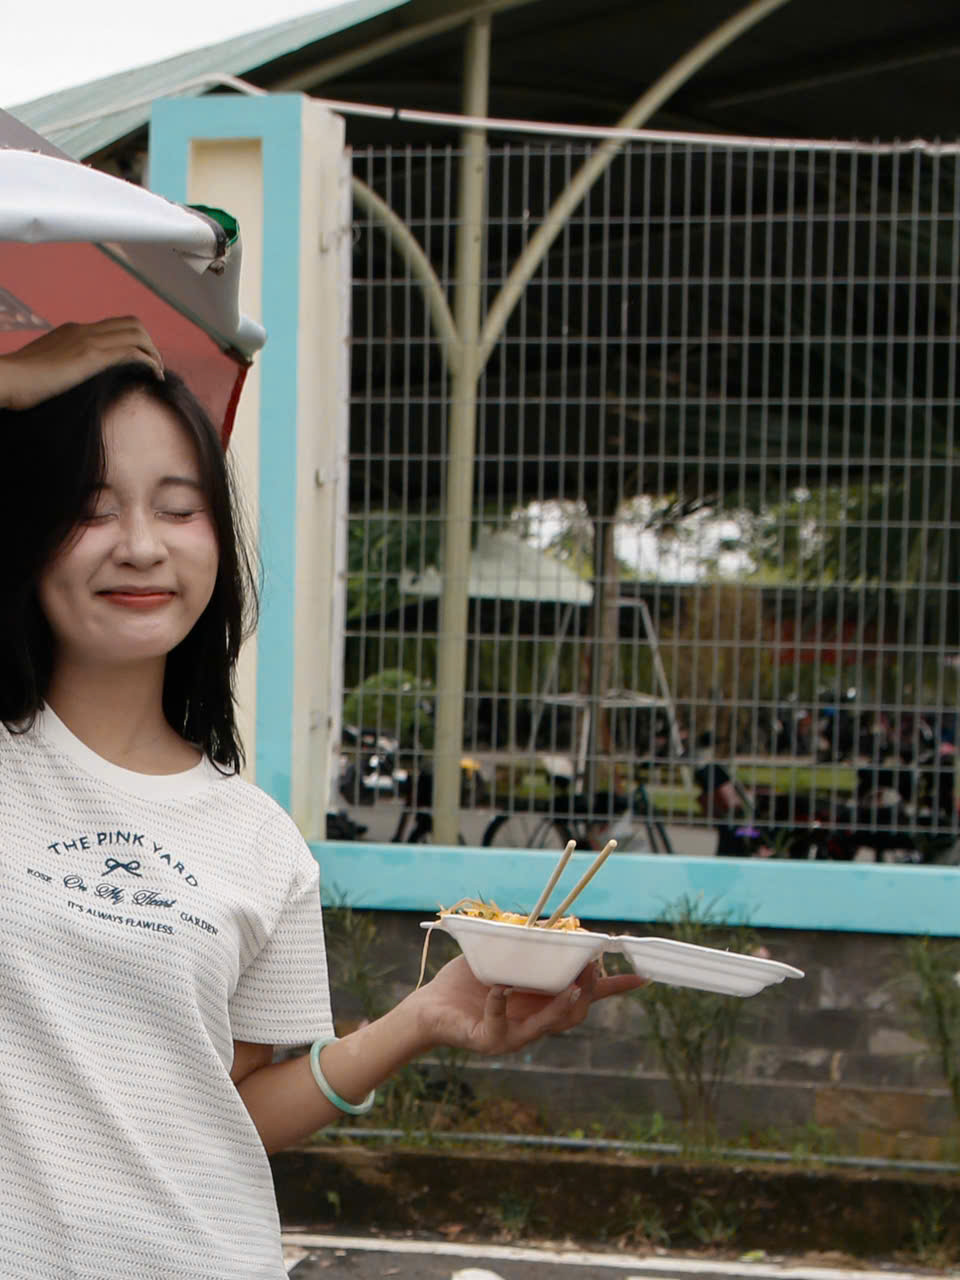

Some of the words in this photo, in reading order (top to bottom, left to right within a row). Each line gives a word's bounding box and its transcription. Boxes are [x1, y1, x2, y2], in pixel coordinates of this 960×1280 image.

[48, 836, 90, 855] THE
[97, 831, 145, 847] PINK
[153, 842, 198, 887] YARD
[68, 900, 84, 912] IT'S
[86, 907, 123, 924] ALWAYS
[180, 911, 218, 936] GARDEN
